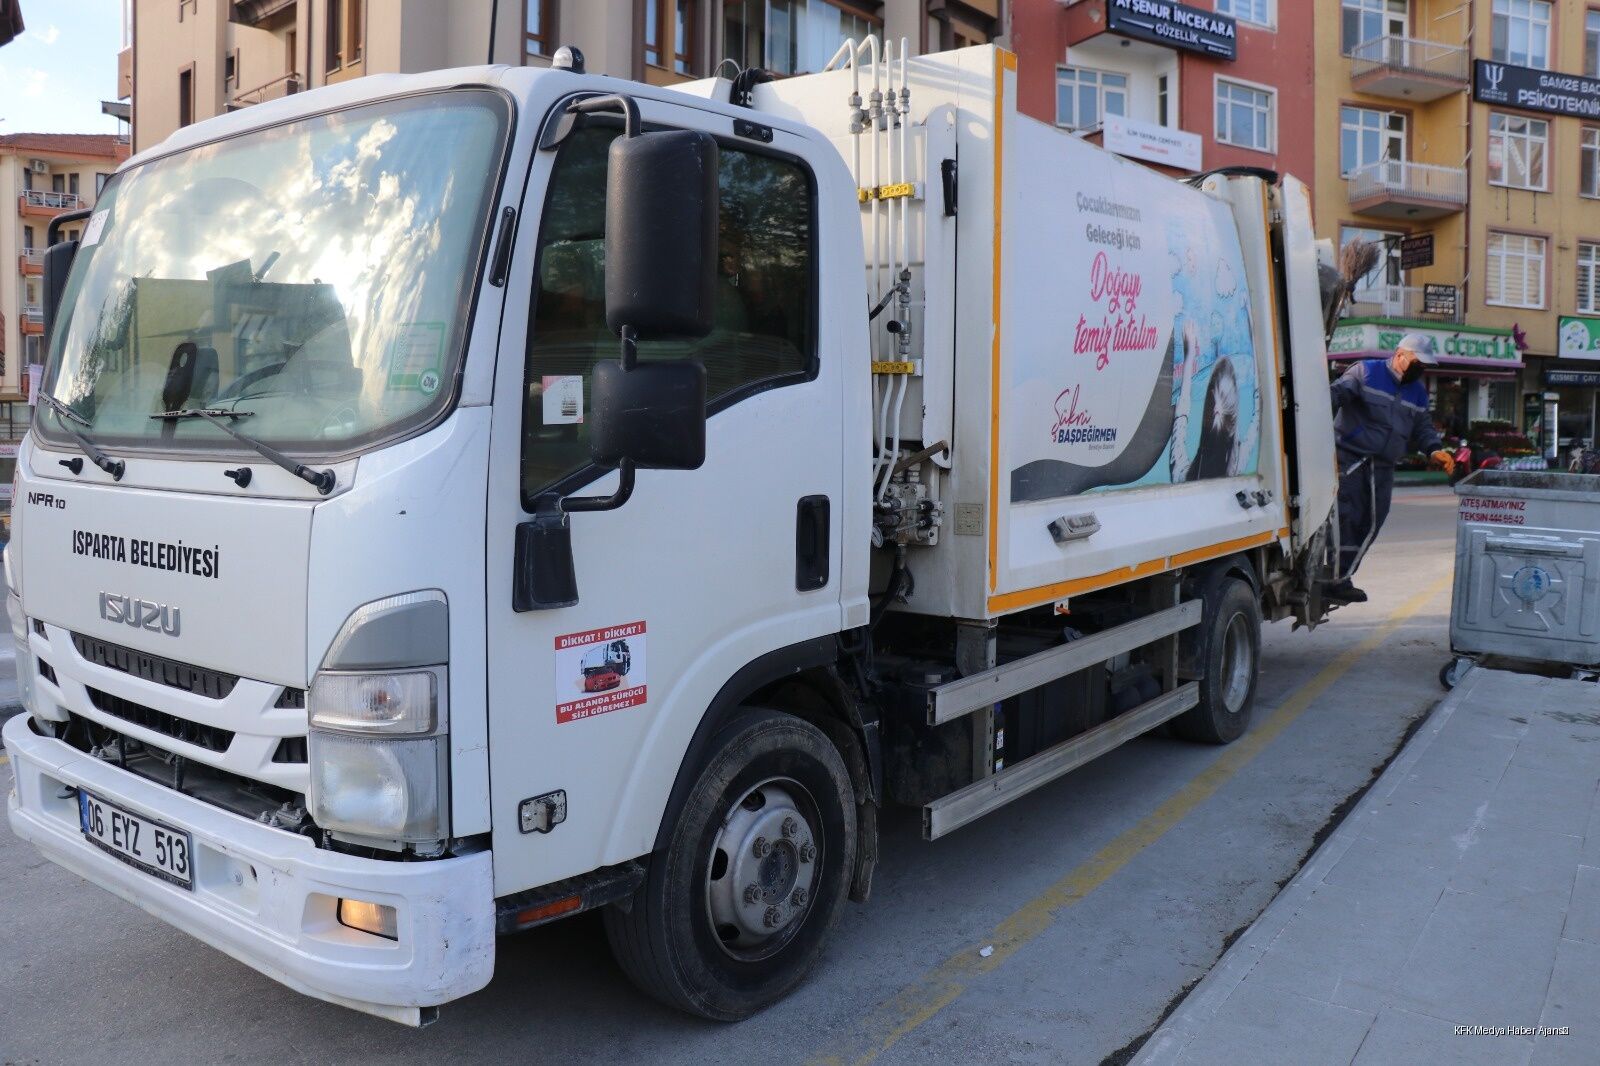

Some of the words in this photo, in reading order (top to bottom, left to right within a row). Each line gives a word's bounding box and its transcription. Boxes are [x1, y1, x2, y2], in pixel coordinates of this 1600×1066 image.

[1155, 23, 1199, 43] GÜZELLİK
[1173, 5, 1235, 38] İNCEKARA
[1540, 75, 1579, 91] GAMZE
[1086, 223, 1125, 250] Geleceği
[1426, 285, 1454, 295] AVUKAT
[1074, 313, 1112, 371] temiz
[1113, 313, 1157, 352] tutalım
[1058, 425, 1117, 445] BAŞDEĞİRMEN
[28, 491, 54, 507] NPR
[55, 499, 66, 509] 10
[1460, 498, 1481, 510] ATEŞ
[1481, 499, 1526, 511] ATMAYINIZ
[72, 529, 126, 562] ISPARTA
[130, 540, 219, 579] BELEDİYESİ
[99, 590, 181, 638] ISUZU
[561, 633, 595, 648] DİKKAT
[604, 625, 637, 639] DİKKAT
[560, 704, 573, 714] BU
[575, 696, 610, 710] ALANDA
[611, 687, 644, 700] SÜRÜCÜ
[571, 710, 589, 720] SİZİ
[591, 700, 630, 715] GÖREMEZ
[88, 799, 104, 838] 06
[112, 811, 141, 857] EYZ
[155, 829, 187, 874] 513
